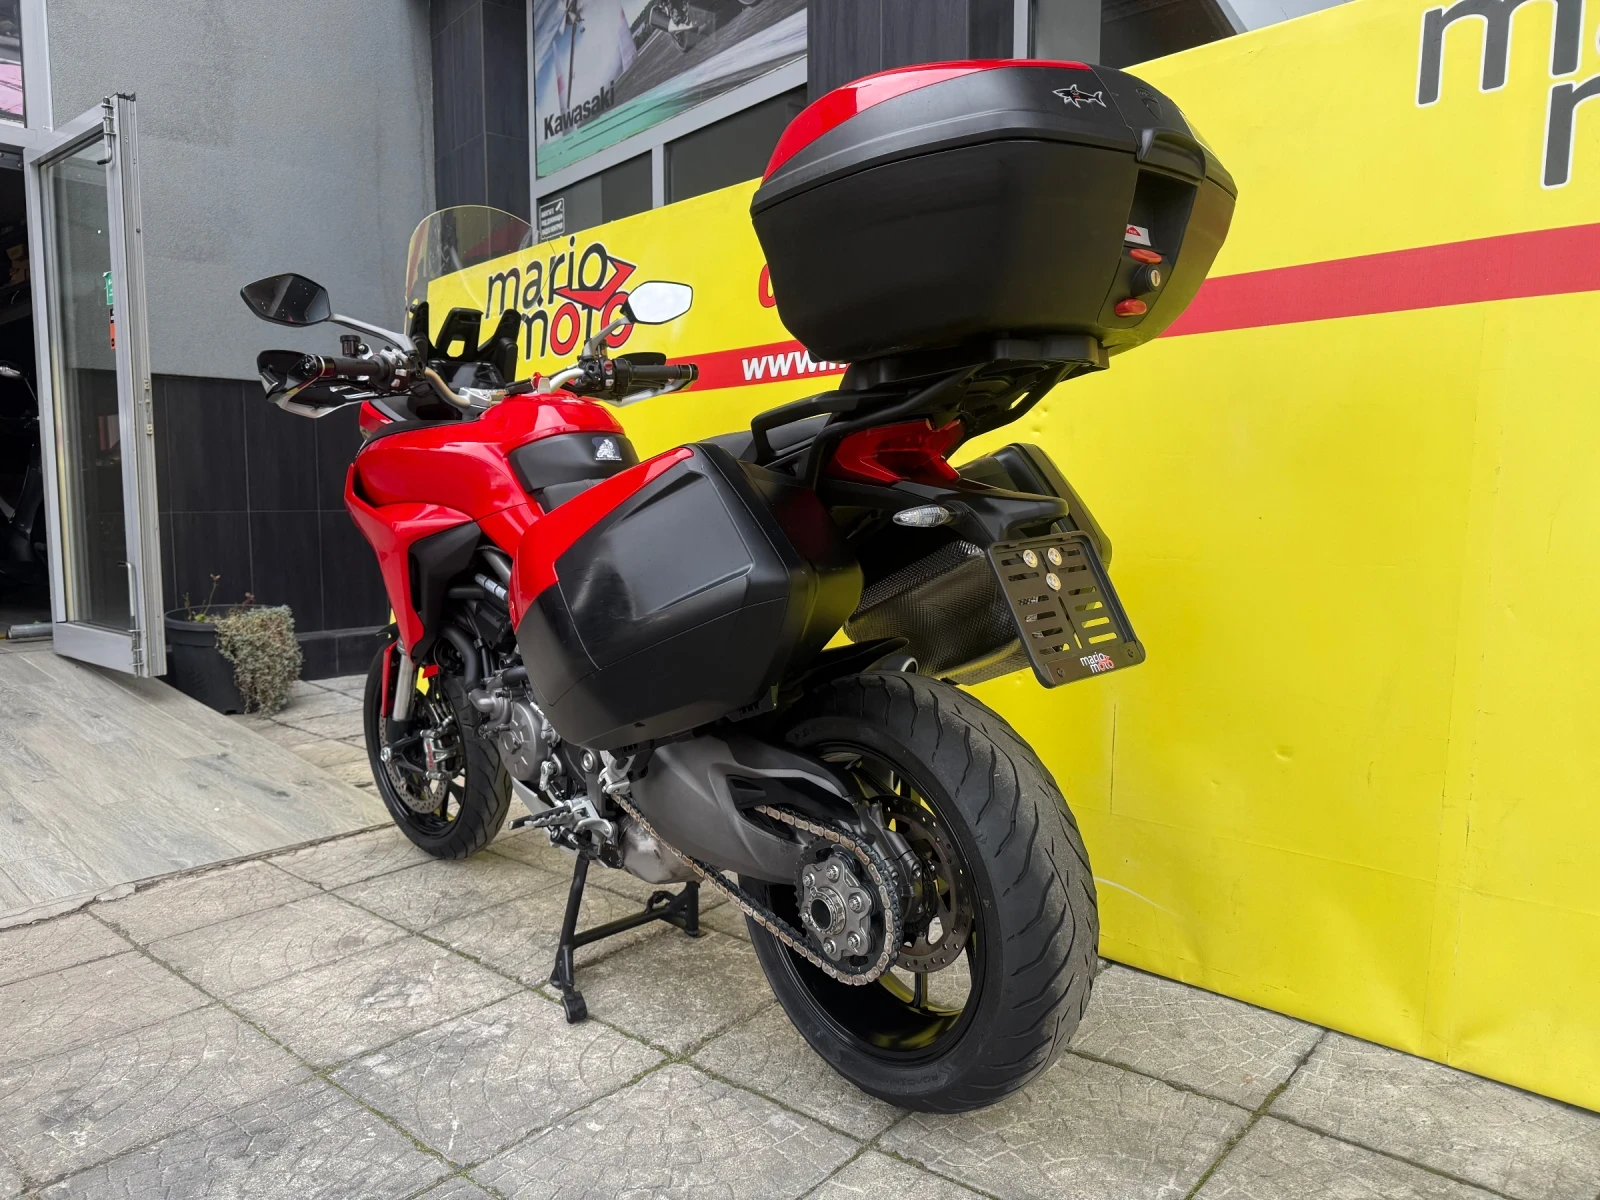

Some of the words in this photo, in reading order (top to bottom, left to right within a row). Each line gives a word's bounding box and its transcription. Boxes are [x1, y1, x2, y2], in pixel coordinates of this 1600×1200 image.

[544, 80, 615, 140] Kawasaki
[485, 235, 609, 319] mario
[521, 291, 635, 360] moto
[1080, 651, 1105, 667] mario
[1090, 660, 1115, 673] moto
